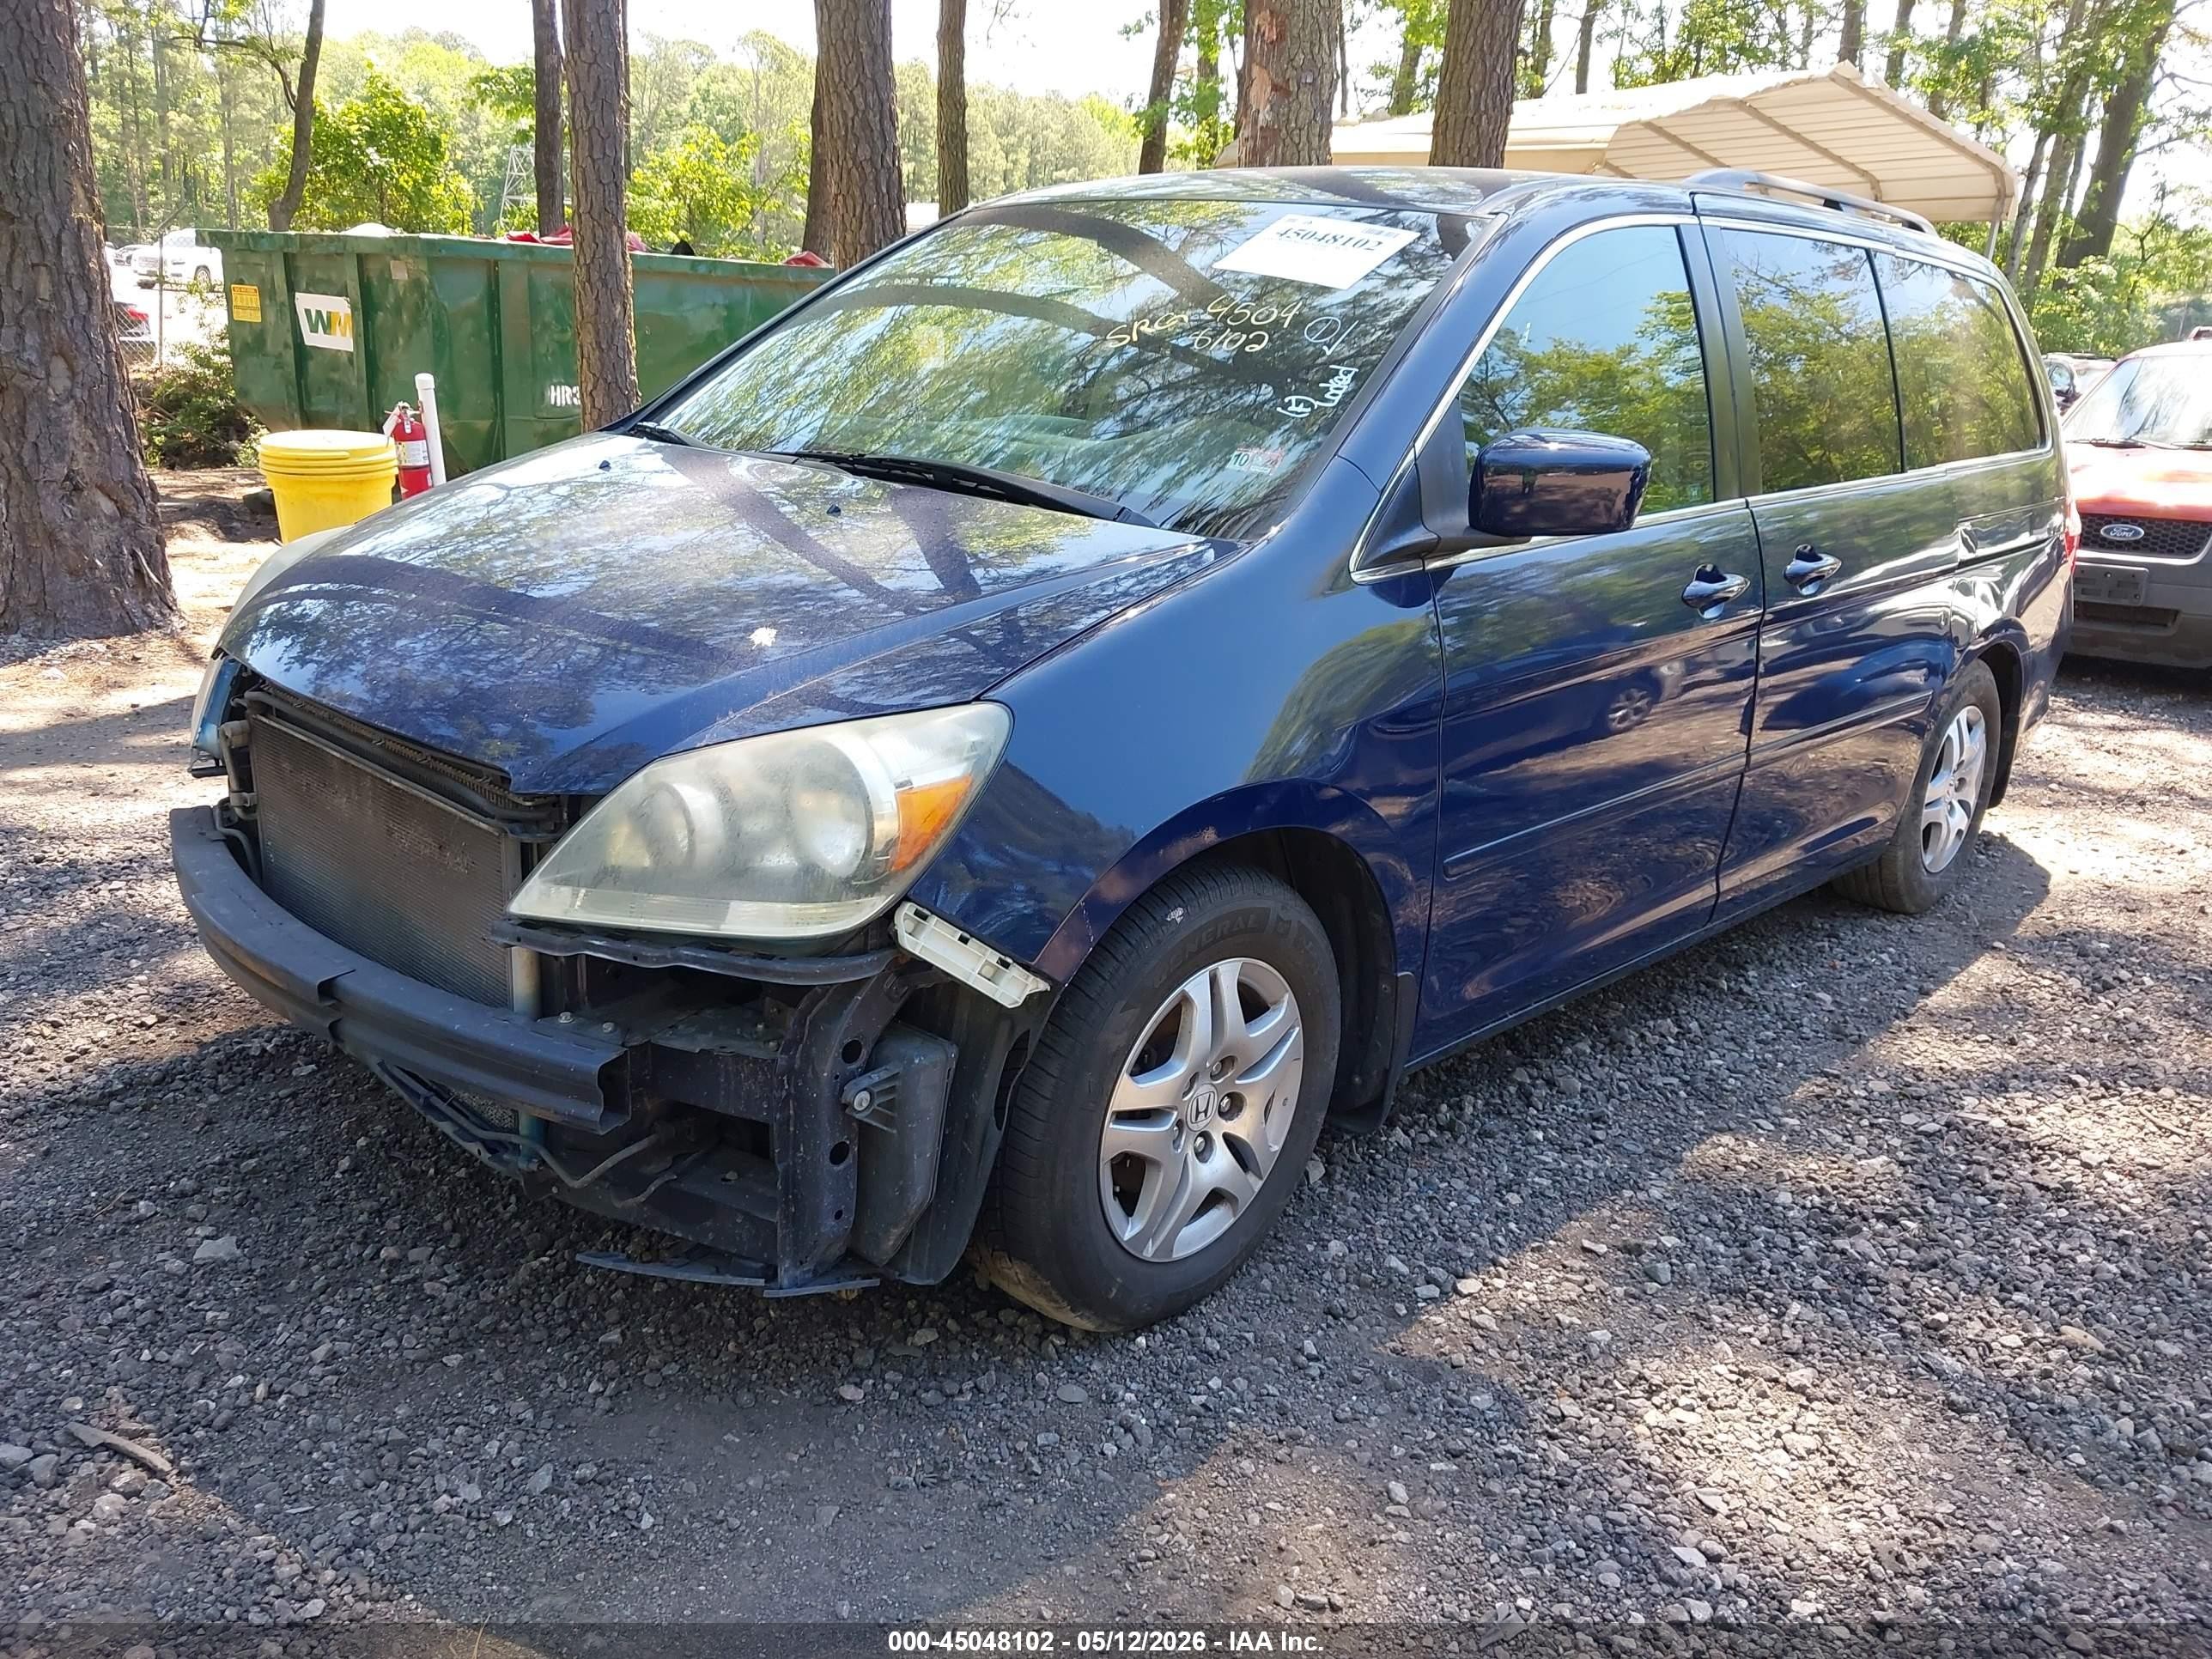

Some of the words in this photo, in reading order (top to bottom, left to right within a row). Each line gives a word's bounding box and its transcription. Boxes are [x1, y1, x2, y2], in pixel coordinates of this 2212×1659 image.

[1276, 227, 1383, 252] 45048102
[304, 308, 352, 337] WM
[1206, 295, 1304, 328] 4504
[1233, 453, 1250, 467] 10
